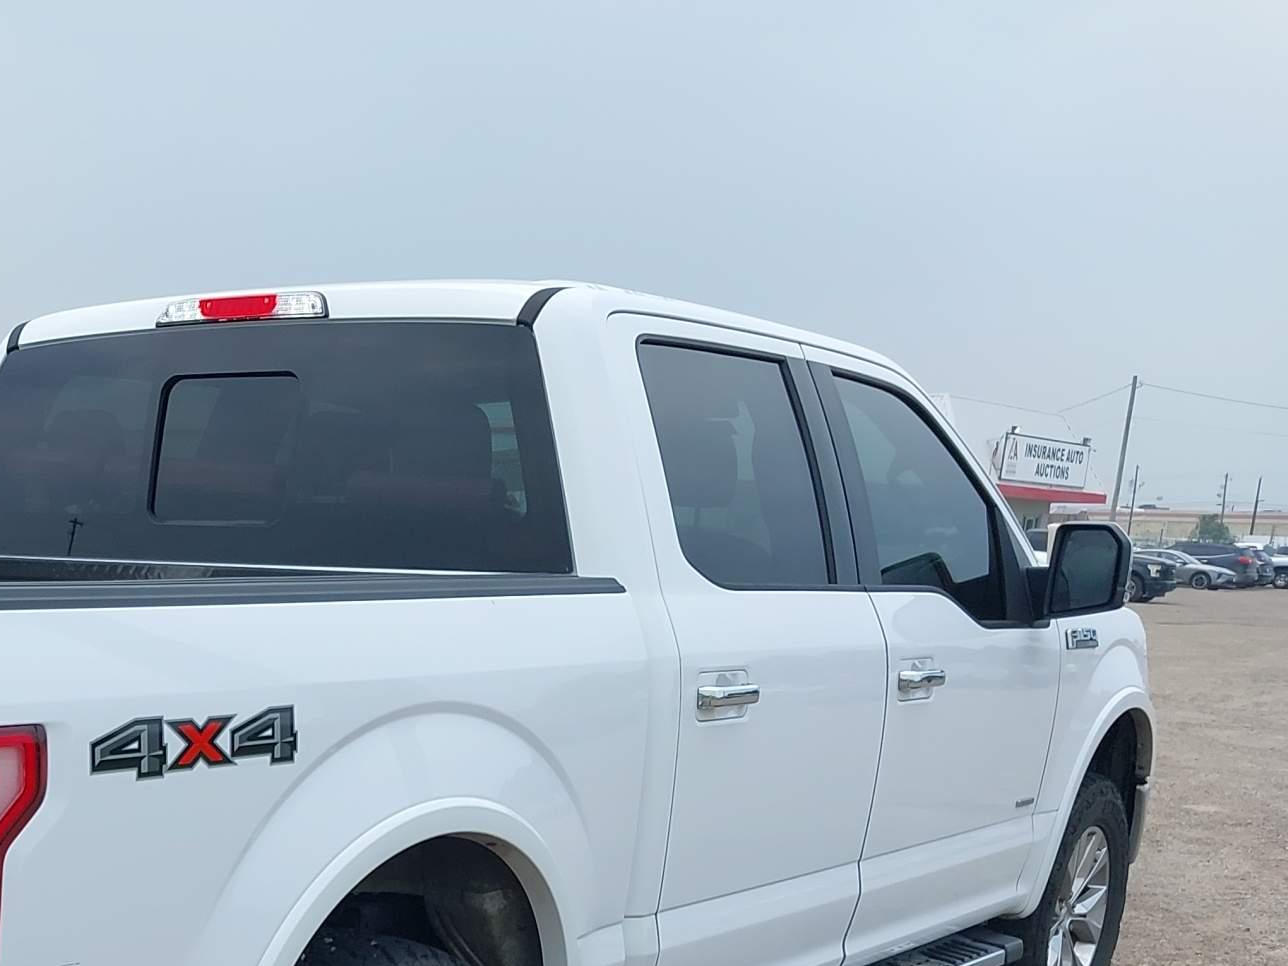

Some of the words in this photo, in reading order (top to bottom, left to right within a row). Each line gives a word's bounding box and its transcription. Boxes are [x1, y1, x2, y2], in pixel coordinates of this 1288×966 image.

[1024, 443, 1066, 462] INSURANCE
[1066, 449, 1084, 465] AUTO
[1034, 463, 1070, 480] AUCTIONS
